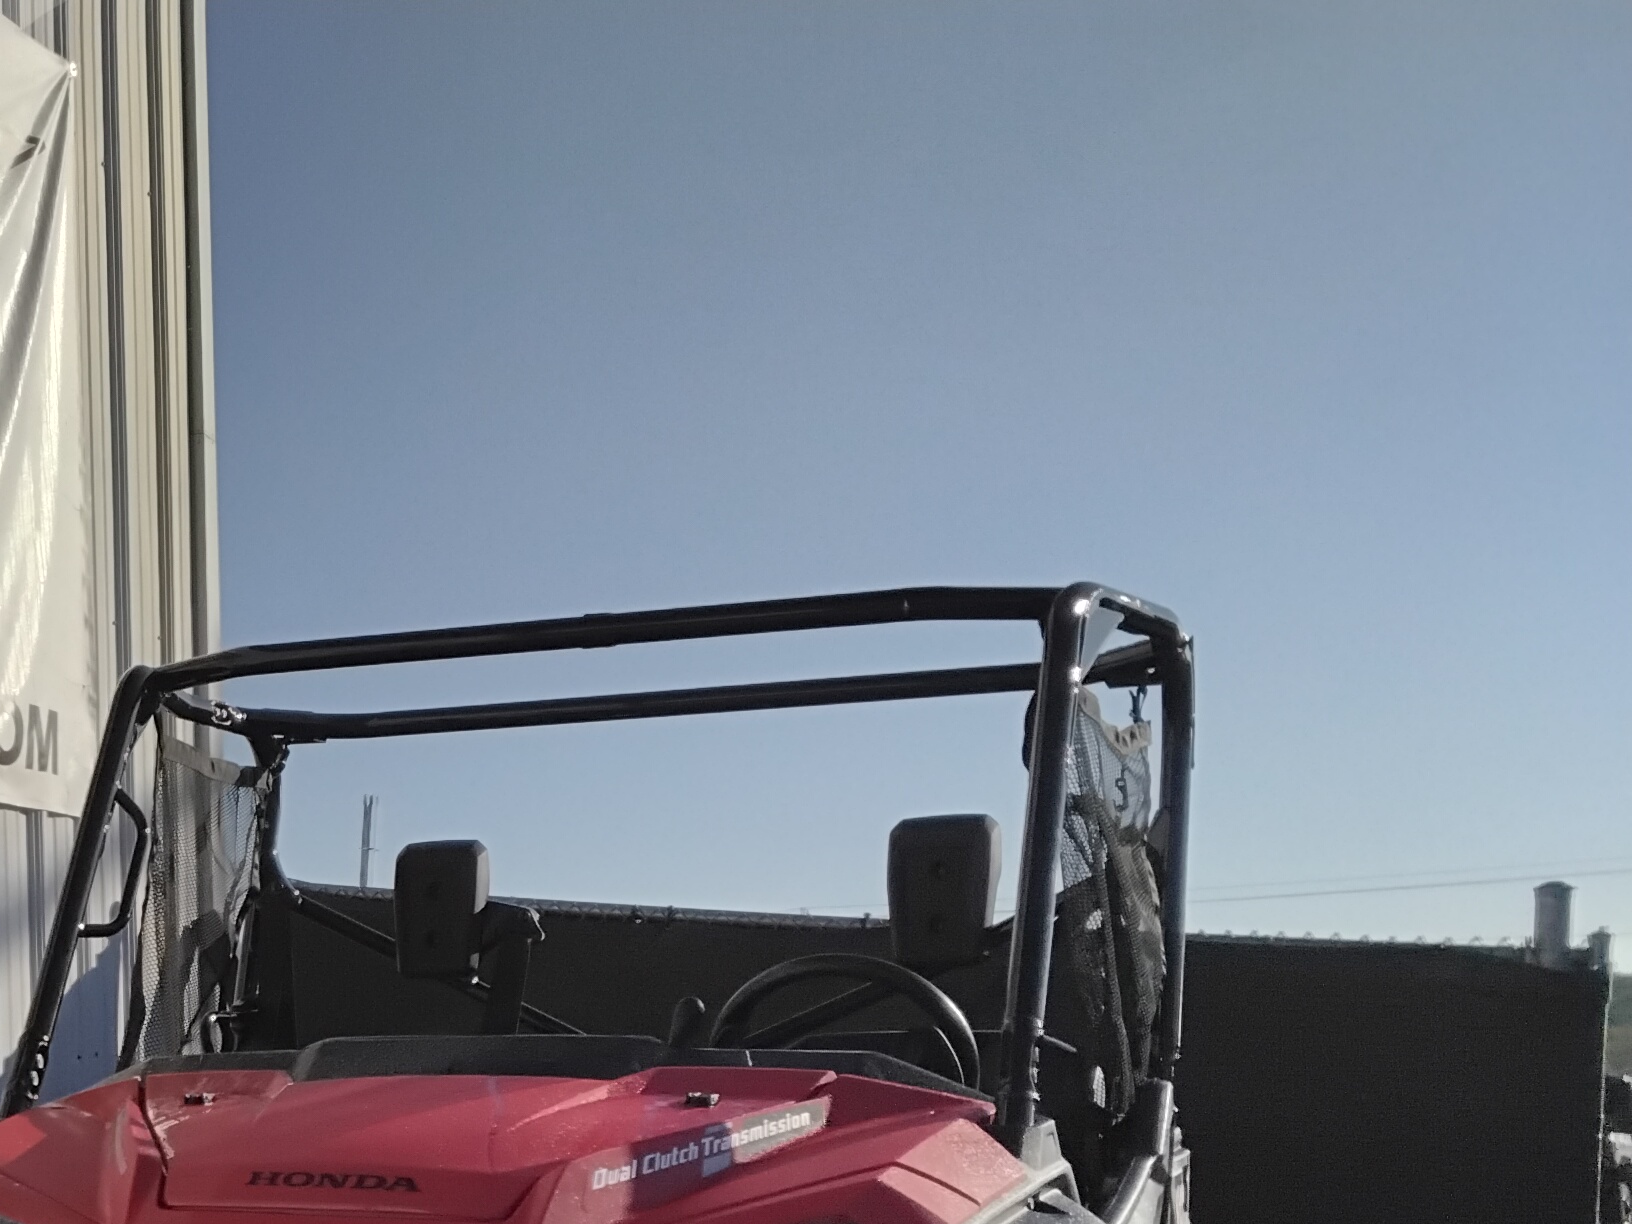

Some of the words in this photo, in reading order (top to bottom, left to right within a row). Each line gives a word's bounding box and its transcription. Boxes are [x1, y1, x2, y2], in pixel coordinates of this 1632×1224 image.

[592, 1159, 638, 1190] Dual
[642, 1142, 699, 1174] Clutch
[701, 1111, 811, 1156] Transmission
[245, 1171, 421, 1193] HONDA
